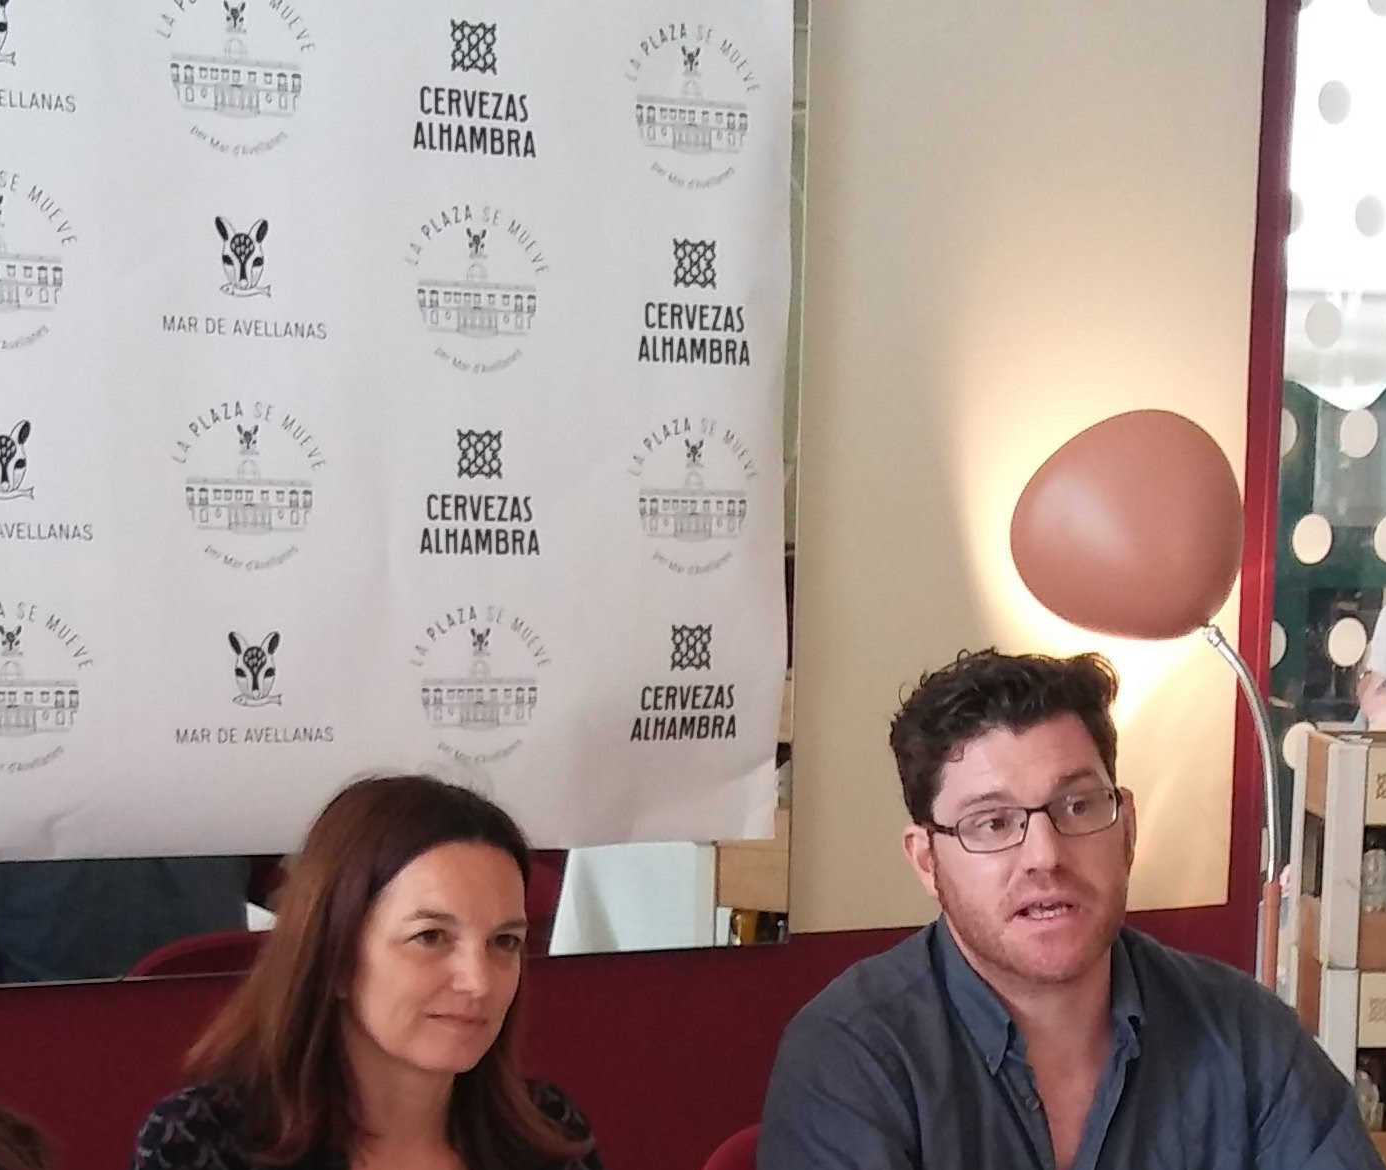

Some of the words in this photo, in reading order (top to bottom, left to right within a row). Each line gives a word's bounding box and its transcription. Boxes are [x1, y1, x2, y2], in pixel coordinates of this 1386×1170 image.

[640, 24, 687, 56] PLAZA
[420, 86, 528, 122] CERVEZAS
[414, 121, 536, 158] ALHAMBRA
[0, 170, 19, 191] SE
[28, 186, 76, 245] MUEVE
[422, 205, 472, 239] PLAZA
[508, 220, 548, 274] MUEVE
[163, 315, 197, 332] MAR
[206, 317, 226, 335] DE
[233, 320, 327, 339] AVELLANAS
[645, 302, 744, 333] CERVEZAS
[638, 336, 749, 366] ALHAMBRA
[170, 440, 190, 464] LA
[189, 401, 243, 437] PLAZA
[282, 415, 325, 469] MUEVE
[644, 418, 690, 451] PLAZA
[427, 494, 532, 522] CERVEZAS
[420, 528, 539, 555] ALHAMBRA
[18, 602, 37, 621] SE
[46, 615, 92, 668] MUEVE
[427, 606, 476, 641] PLAZA
[511, 618, 550, 666] MUEVE
[641, 685, 734, 711] CERVEZAS
[176, 728, 210, 743] MAR
[218, 728, 237, 744] DE
[244, 726, 333, 743] AVELLANAS
[631, 714, 736, 741] ALHAMBRA
